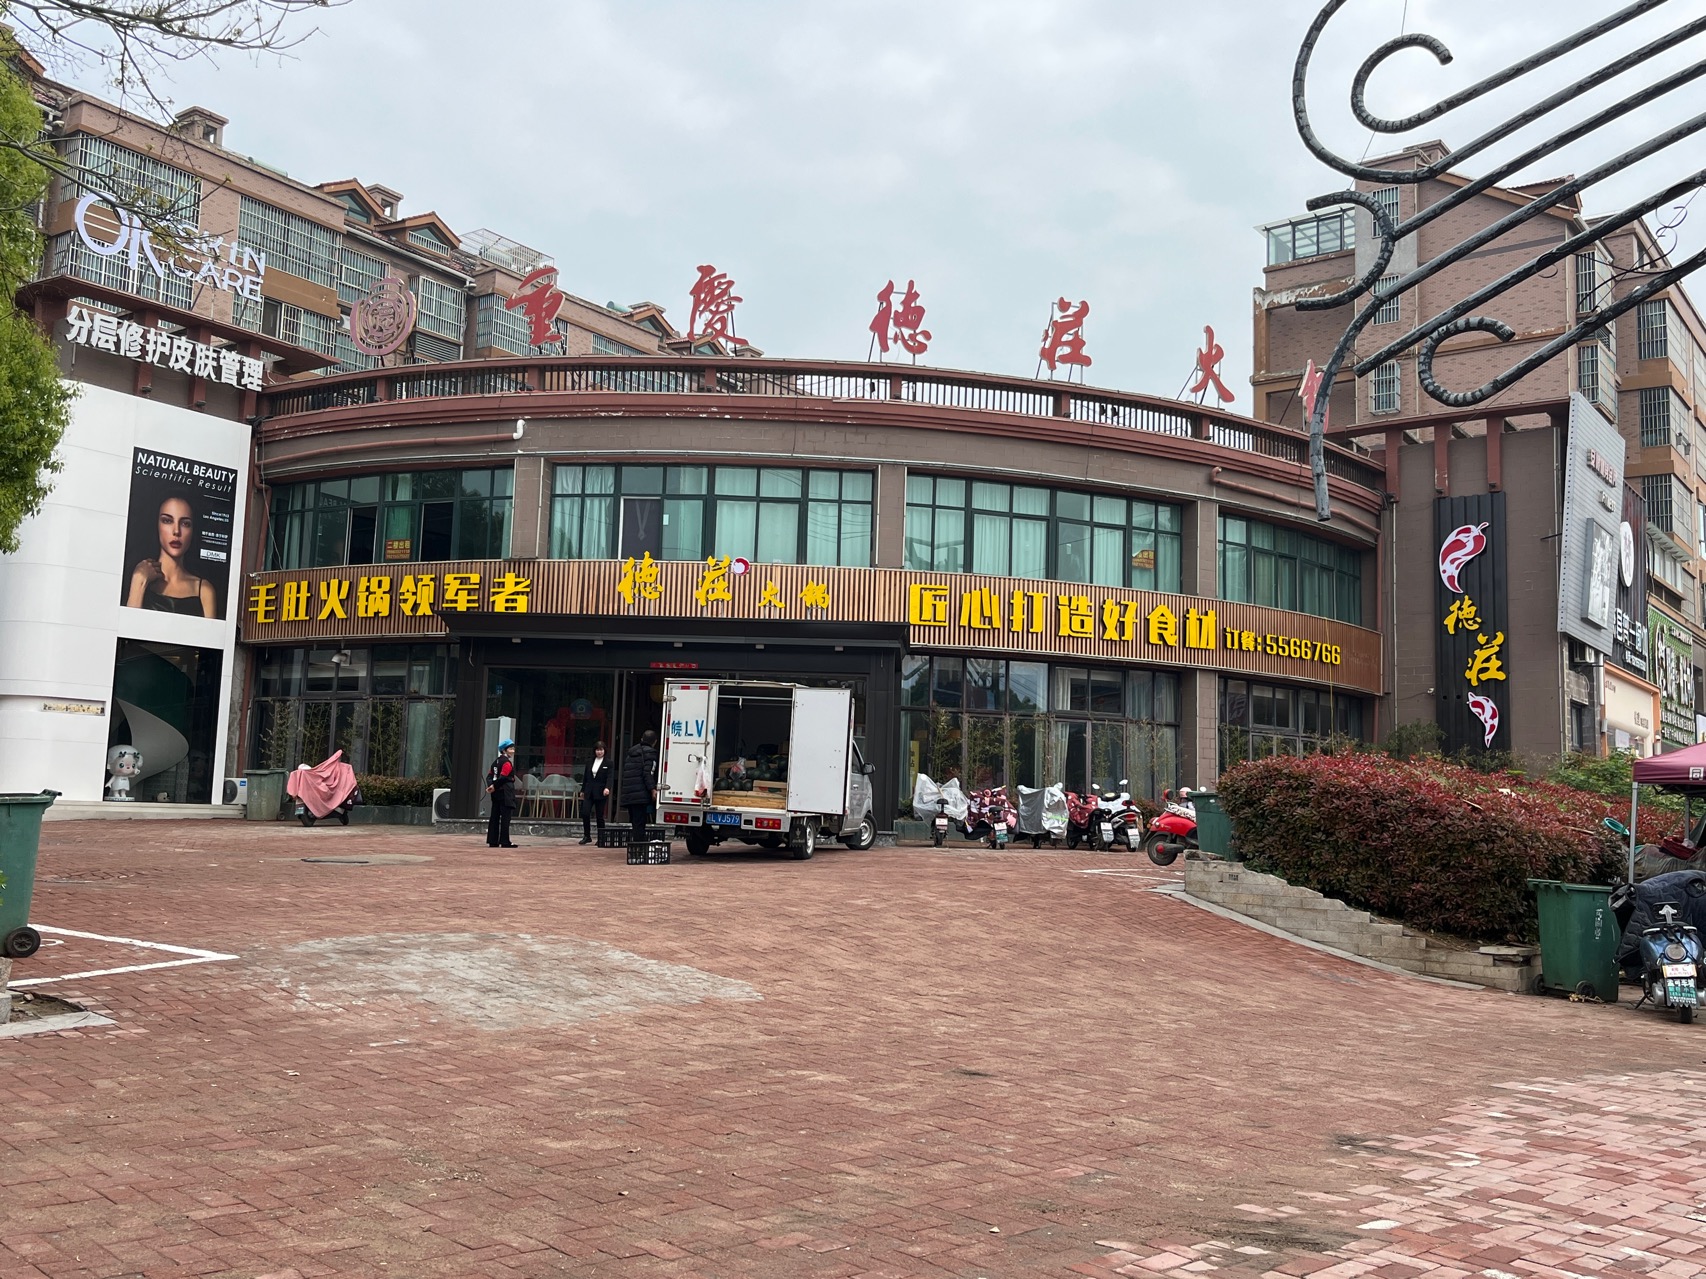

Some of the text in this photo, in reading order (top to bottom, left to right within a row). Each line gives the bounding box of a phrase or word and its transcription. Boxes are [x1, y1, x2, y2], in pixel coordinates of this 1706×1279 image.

[168, 255, 264, 301] CARE
[65, 305, 264, 392] 分层修护皮肤管理
[135, 466, 232, 493] Scientific Result
[137, 452, 236, 484] NATURAL BEAUTY
[248, 572, 531, 624] 毛肚火锅领军者
[909, 583, 1217, 650] 匠心打造好食材
